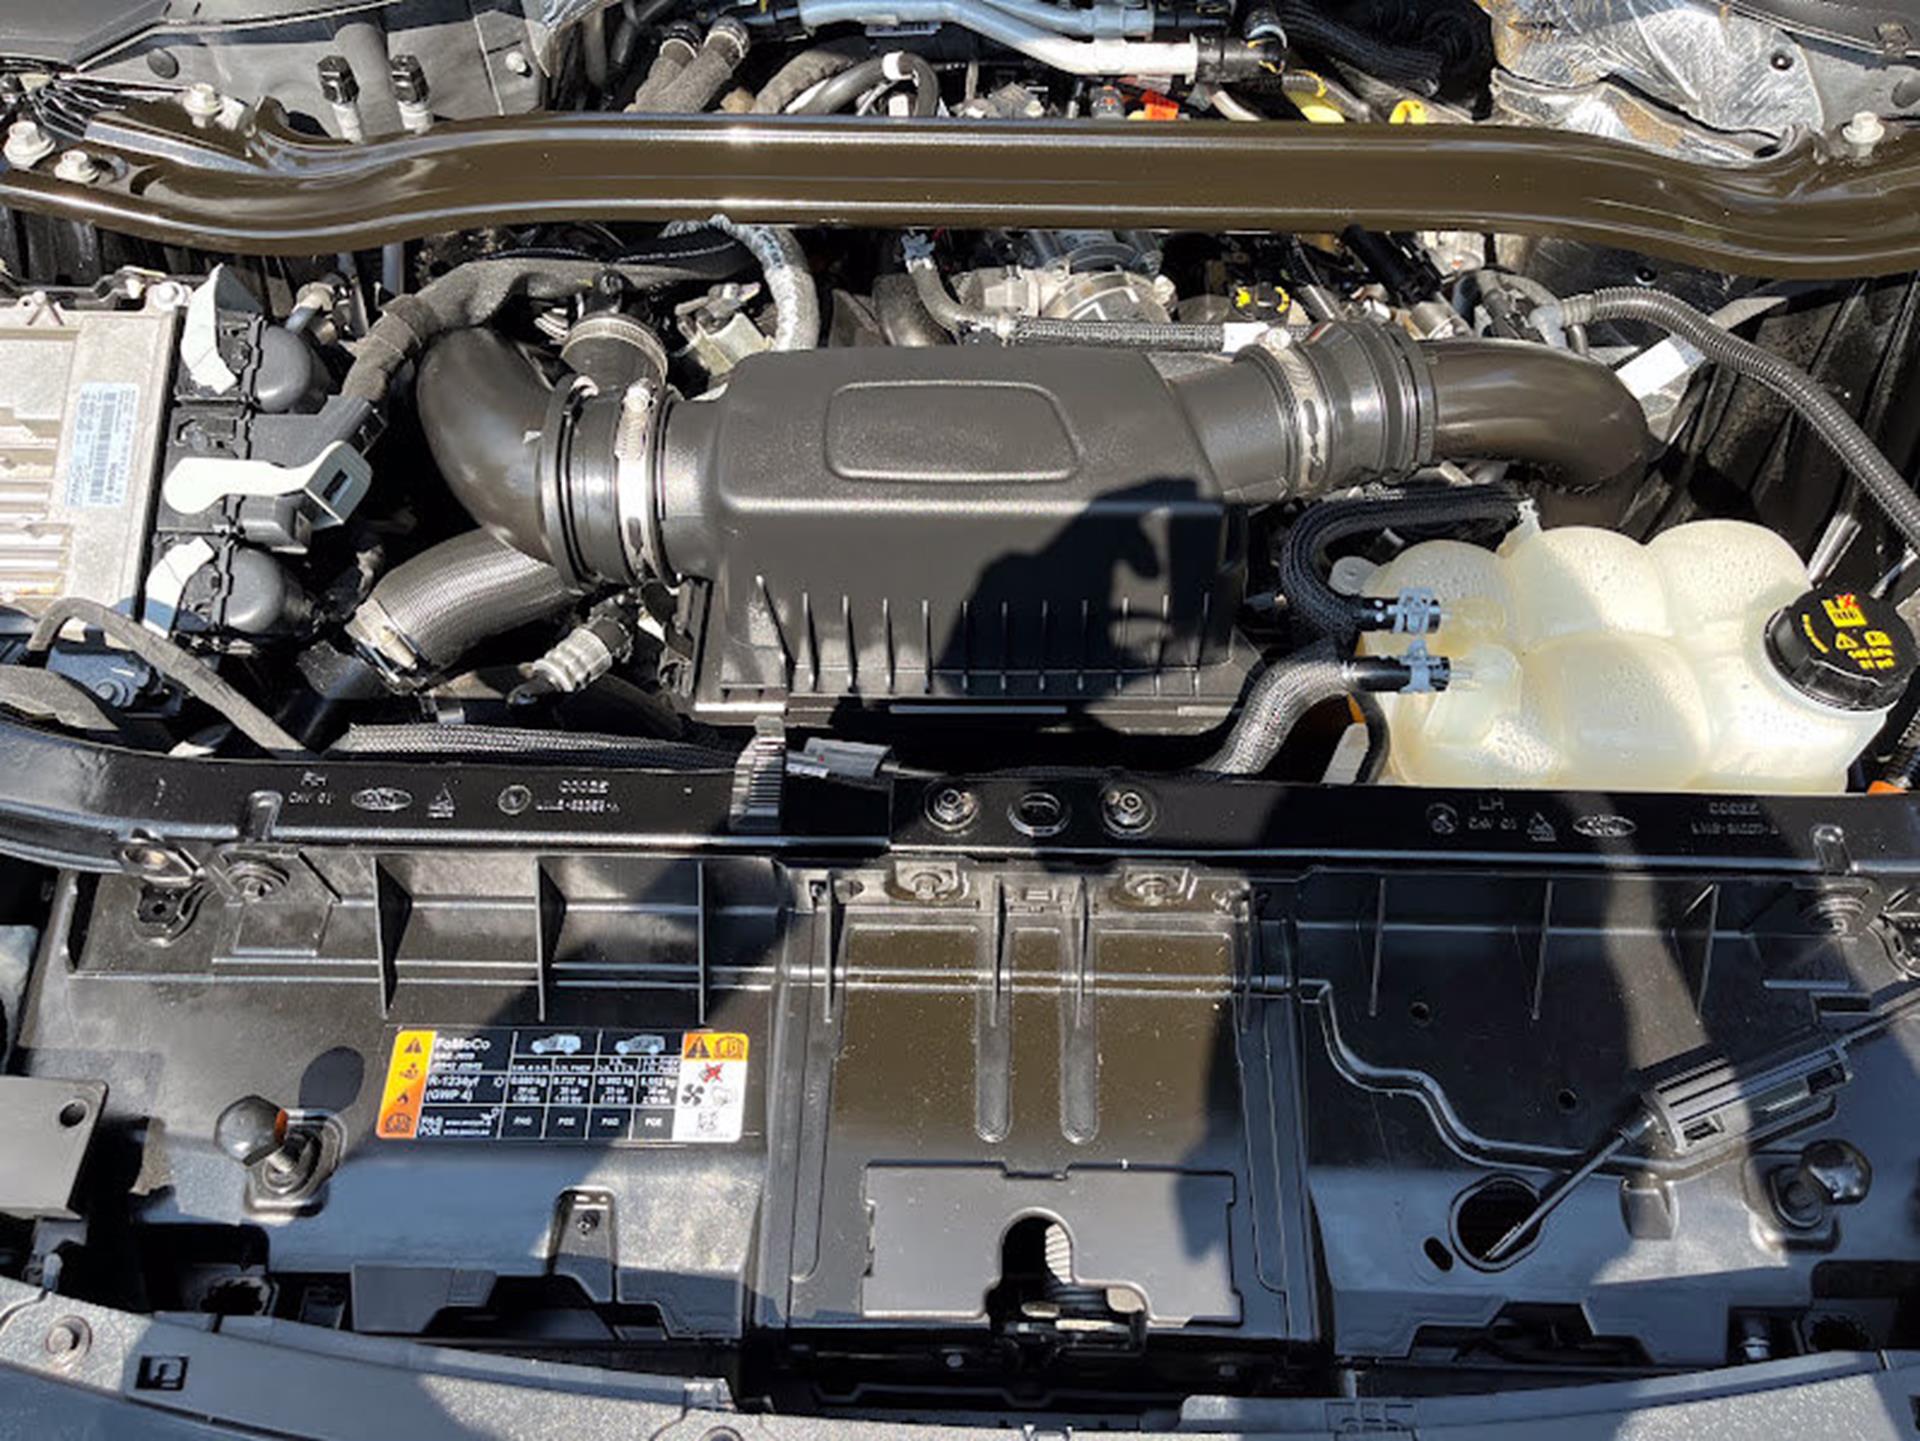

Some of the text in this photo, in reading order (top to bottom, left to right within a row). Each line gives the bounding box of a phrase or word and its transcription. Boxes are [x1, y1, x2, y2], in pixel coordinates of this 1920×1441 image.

[435, 1037, 491, 1051] FoMoCo
[427, 1075, 480, 1089] R-1234yf
[425, 1089, 460, 1102] (GWP
